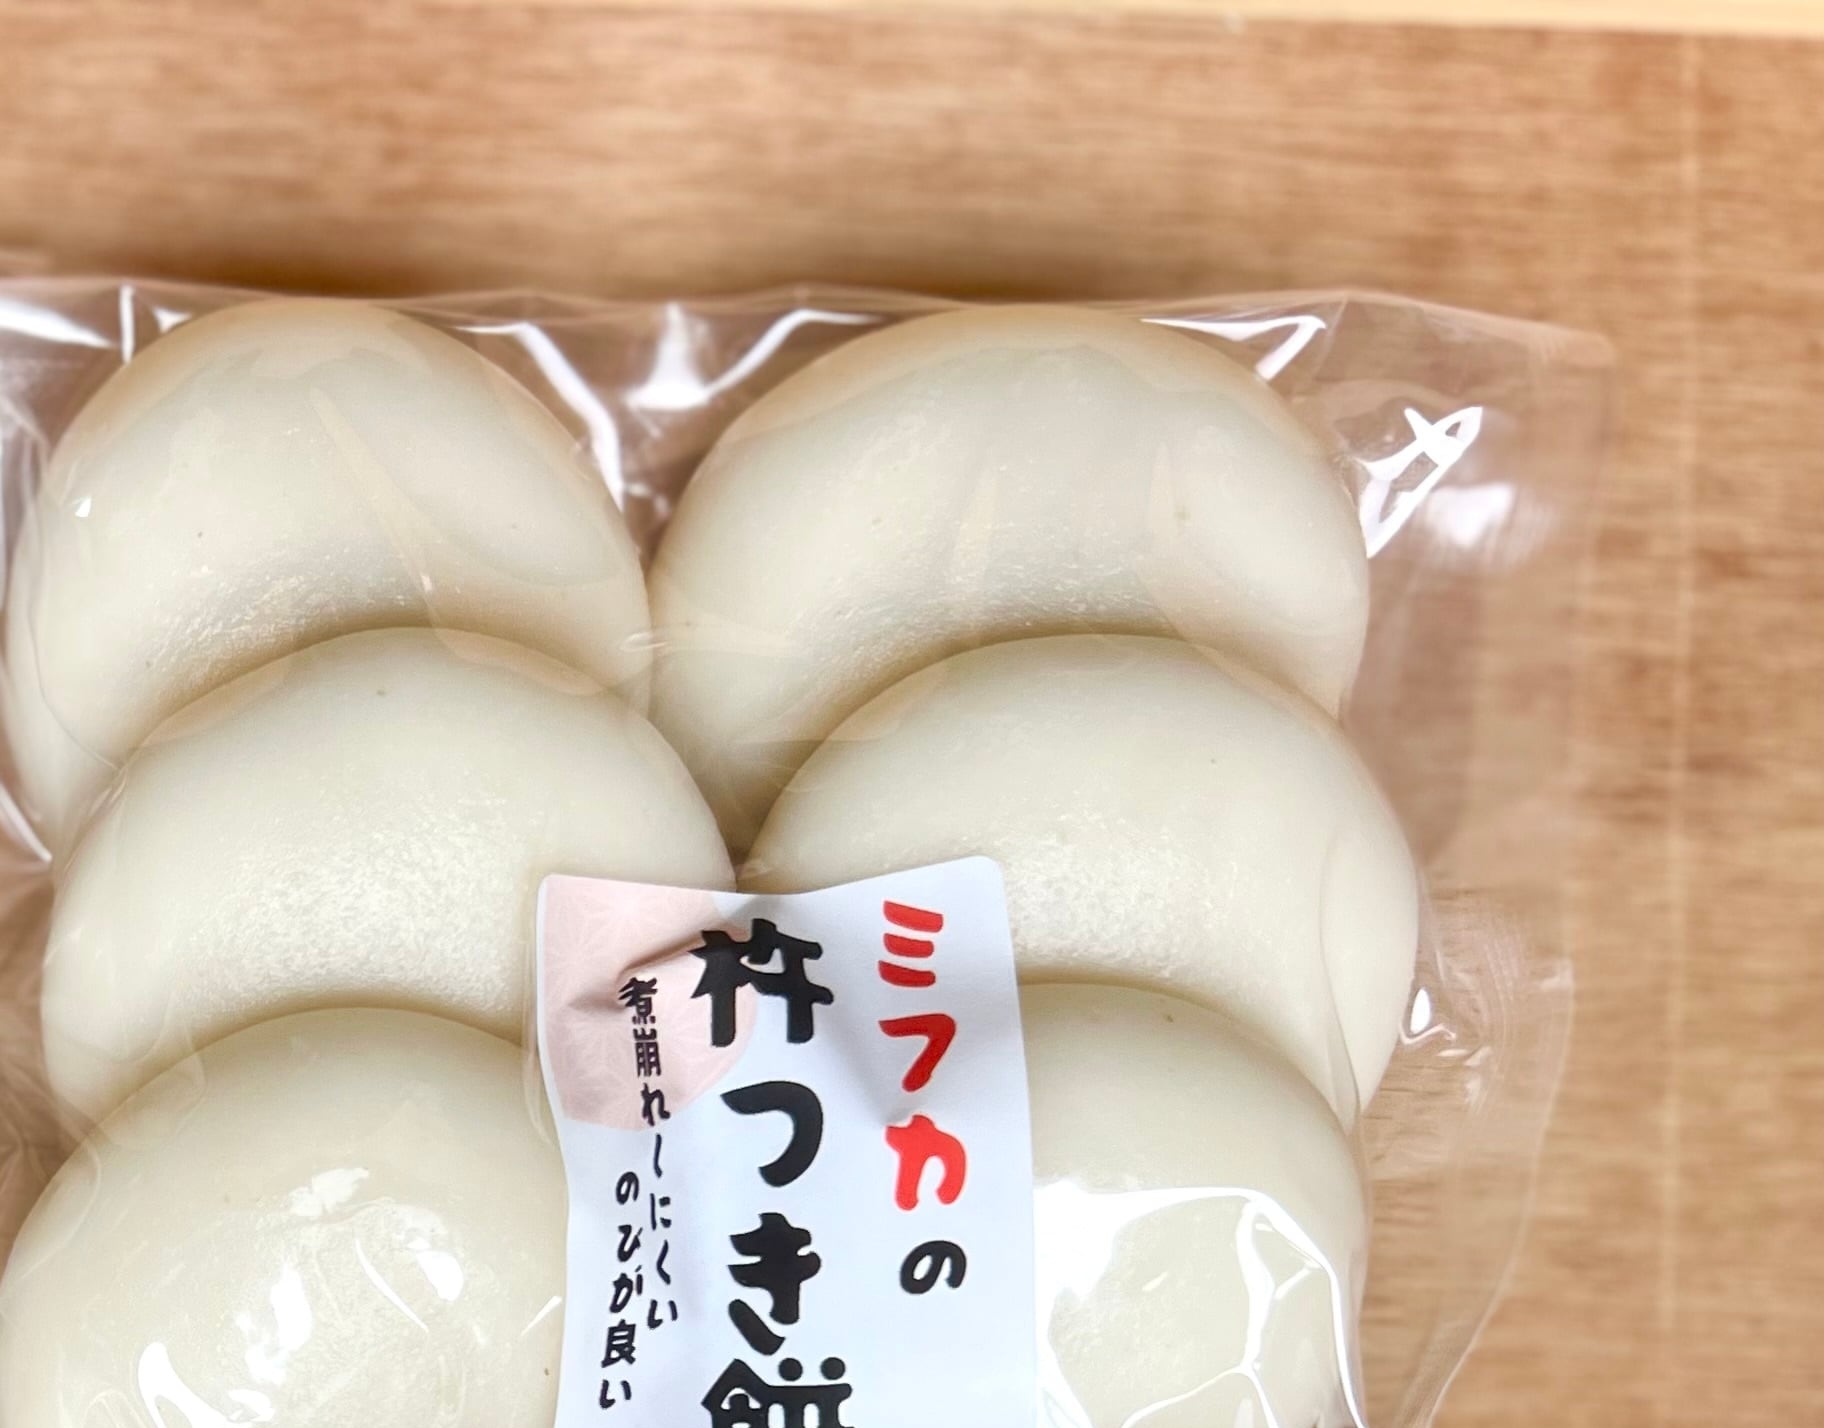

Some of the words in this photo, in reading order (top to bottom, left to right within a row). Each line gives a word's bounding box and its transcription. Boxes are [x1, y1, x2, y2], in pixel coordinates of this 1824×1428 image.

[880, 902, 966, 1294] ミフカの
[599, 1172, 643, 1409] のびが良い
